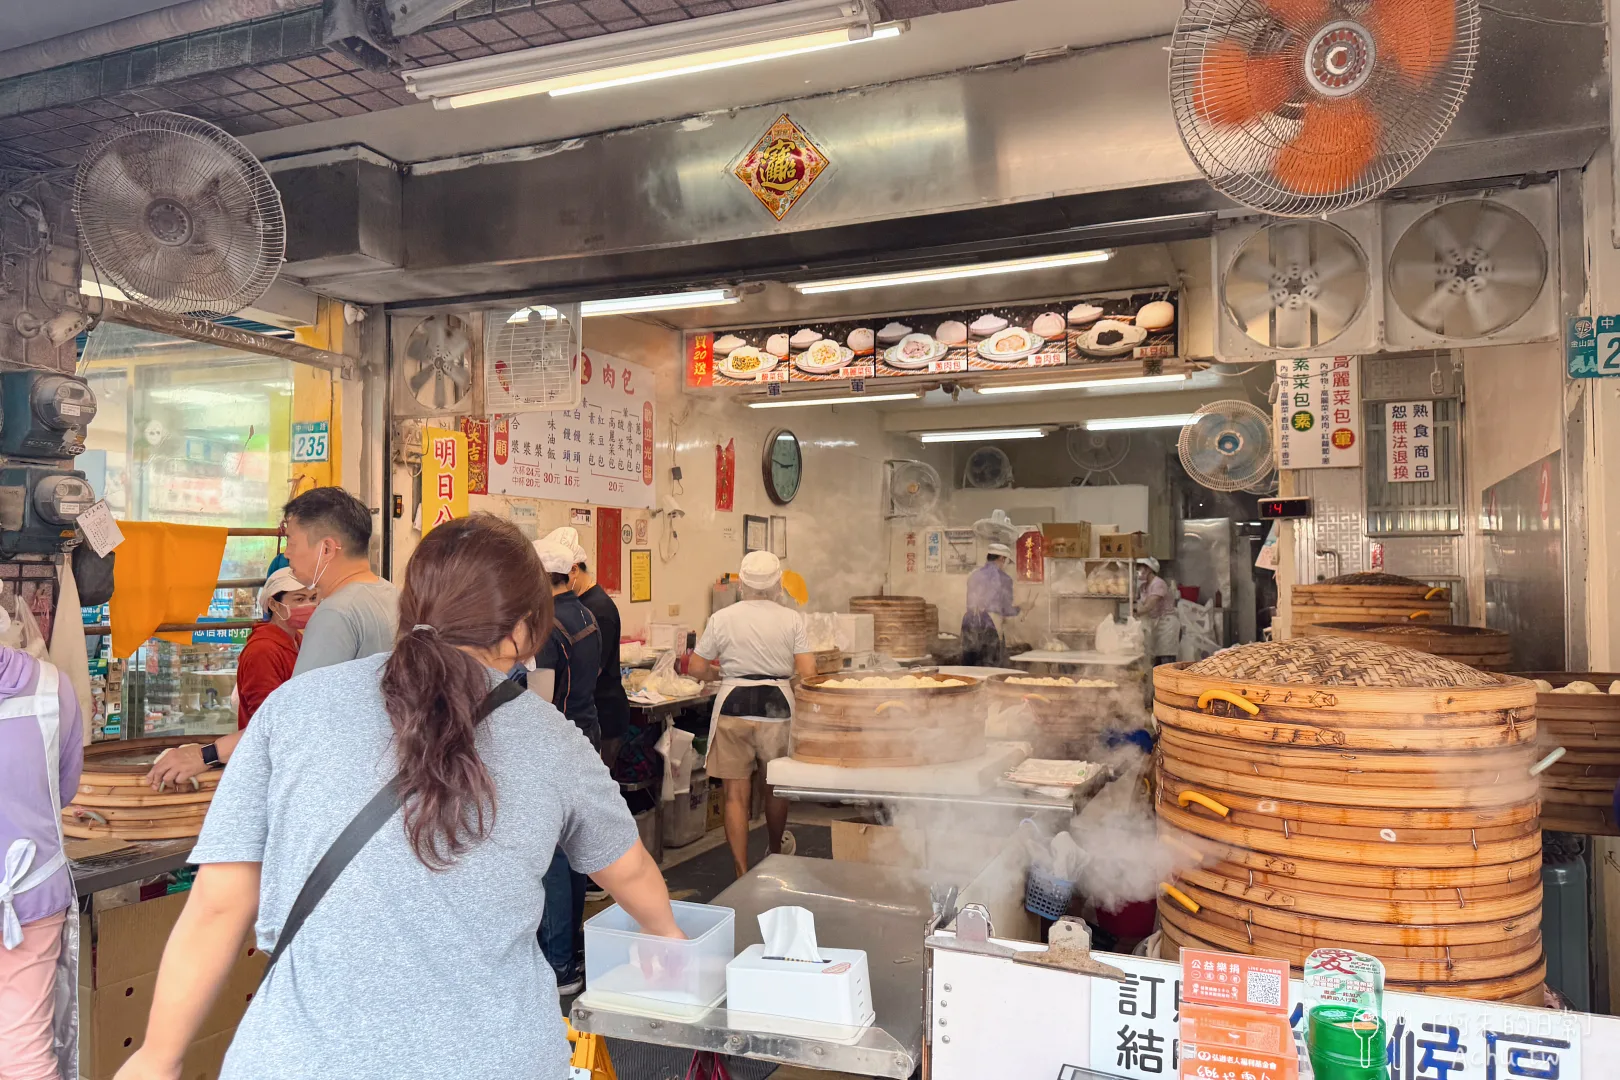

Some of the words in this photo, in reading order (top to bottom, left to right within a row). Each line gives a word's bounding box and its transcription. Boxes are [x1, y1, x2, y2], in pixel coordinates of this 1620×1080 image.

[1570, 339, 1595, 348] 金山區
[1292, 358, 1310, 408] 素菜包
[1332, 356, 1351, 424] 高麗菜包
[296, 435, 326, 457] 235
[588, 412, 596, 465] 素菜包
[597, 414, 605, 467] 紅豆包
[1294, 414, 1311, 429] 素
[1391, 405, 1409, 479] 恕無法退換
[1413, 404, 1429, 479] 熟食商品
[543, 473, 561, 484] 30元
[564, 476, 580, 487] 16元
[608, 482, 625, 493] 20元
[1191, 959, 1240, 974] 公益樂捐
[1118, 973, 1179, 1022] 訂
[1116, 1024, 1179, 1073] 結
